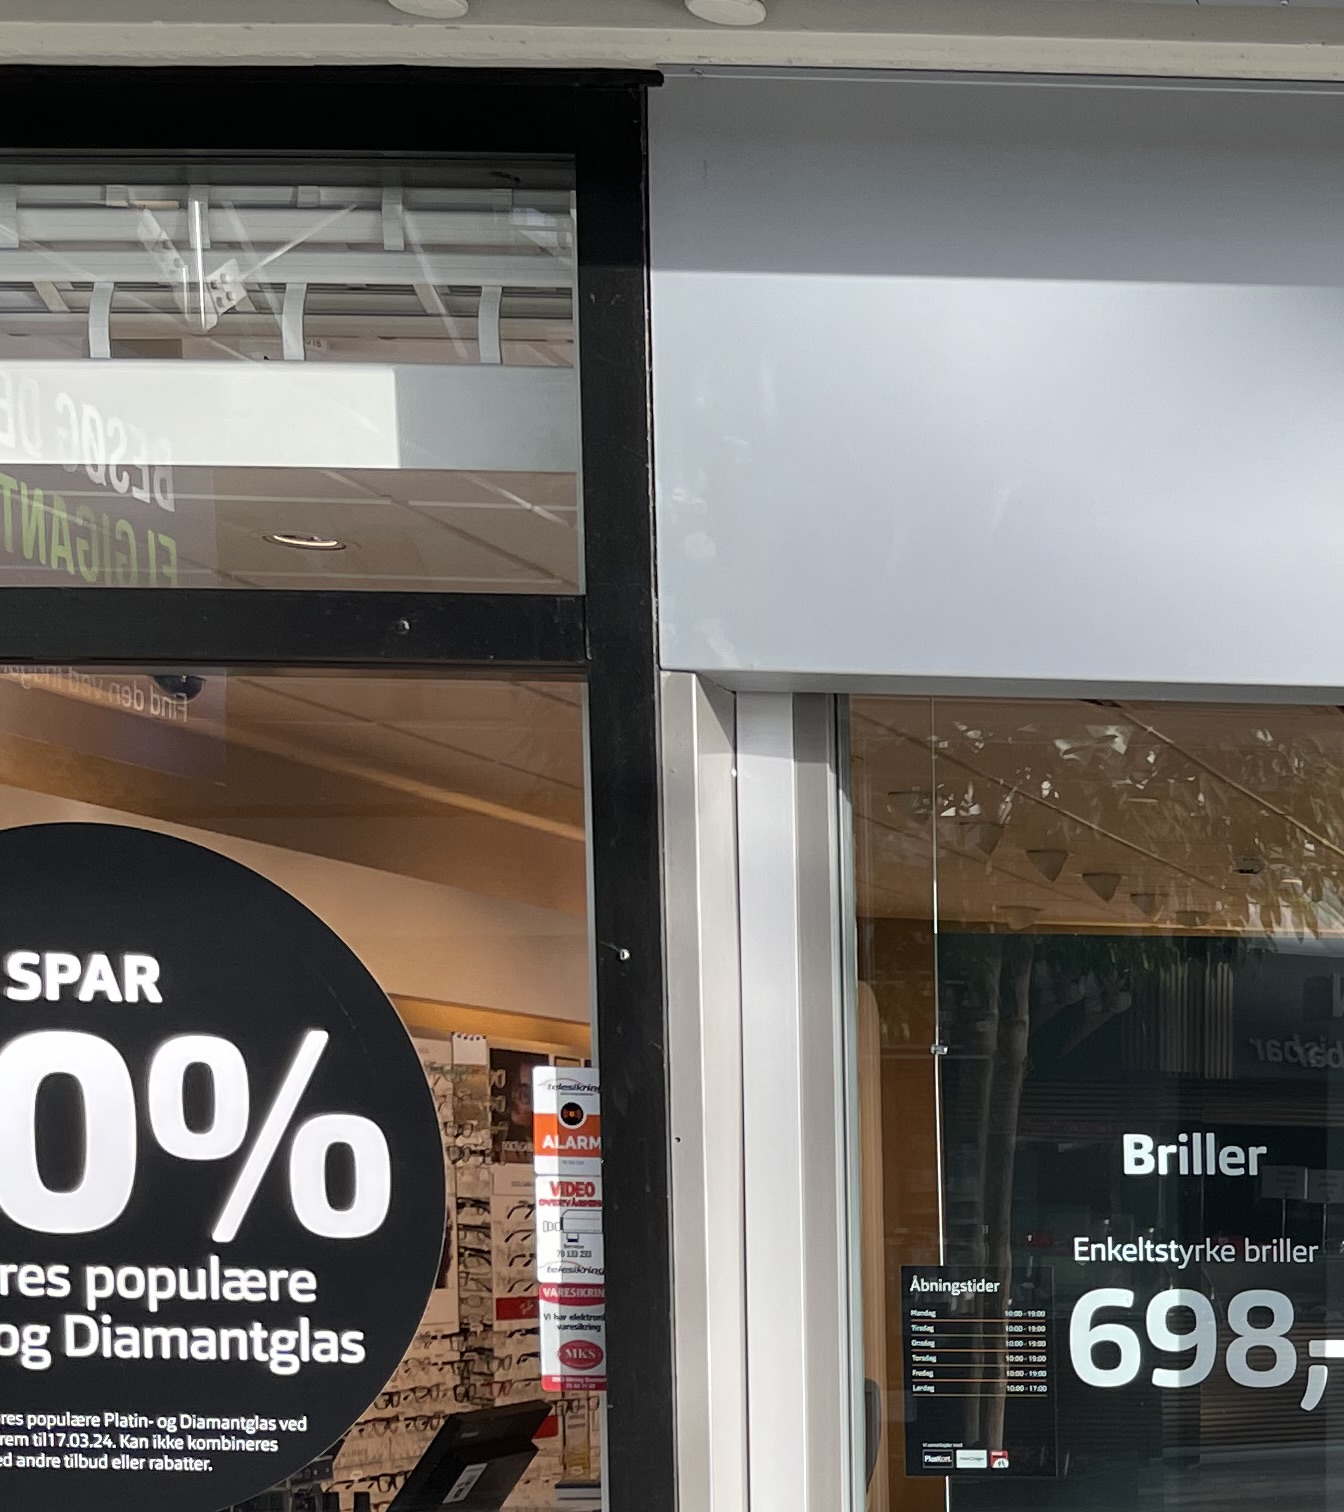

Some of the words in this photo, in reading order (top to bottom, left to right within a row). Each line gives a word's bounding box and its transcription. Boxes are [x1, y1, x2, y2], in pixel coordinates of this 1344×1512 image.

[4, 951, 163, 1003] SPAR
[0, 1029, 391, 1243] 0%
[542, 1135, 601, 1149] ALARM
[1122, 1132, 1268, 1176] Briller
[550, 1181, 596, 1197] VIDEO
[1073, 1236, 1236, 1269] Enkeltstyrke
[1244, 1238, 1319, 1263] briller
[86, 1255, 317, 1312] populære
[542, 1287, 604, 1298] VARESIKRIN
[910, 1275, 1000, 1296] Åbningstider
[65, 1314, 366, 1376] Diamantglas
[565, 1348, 596, 1359] MKS
[27, 1411, 100, 1430] populære
[104, 1412, 154, 1428] Platin-
[157, 1416, 177, 1433] og
[180, 1413, 276, 1434] Diamantglas
[280, 1416, 307, 1432] ved
[120, 1434, 148, 1450] Kan
[152, 1434, 184, 1450] ikke
[187, 1435, 278, 1452] kombineres
[16, 1454, 60, 1469] andre
[64, 1453, 108, 1470] tilbud
[112, 1454, 144, 1470] eller
[149, 1455, 213, 1472] rabatter.
